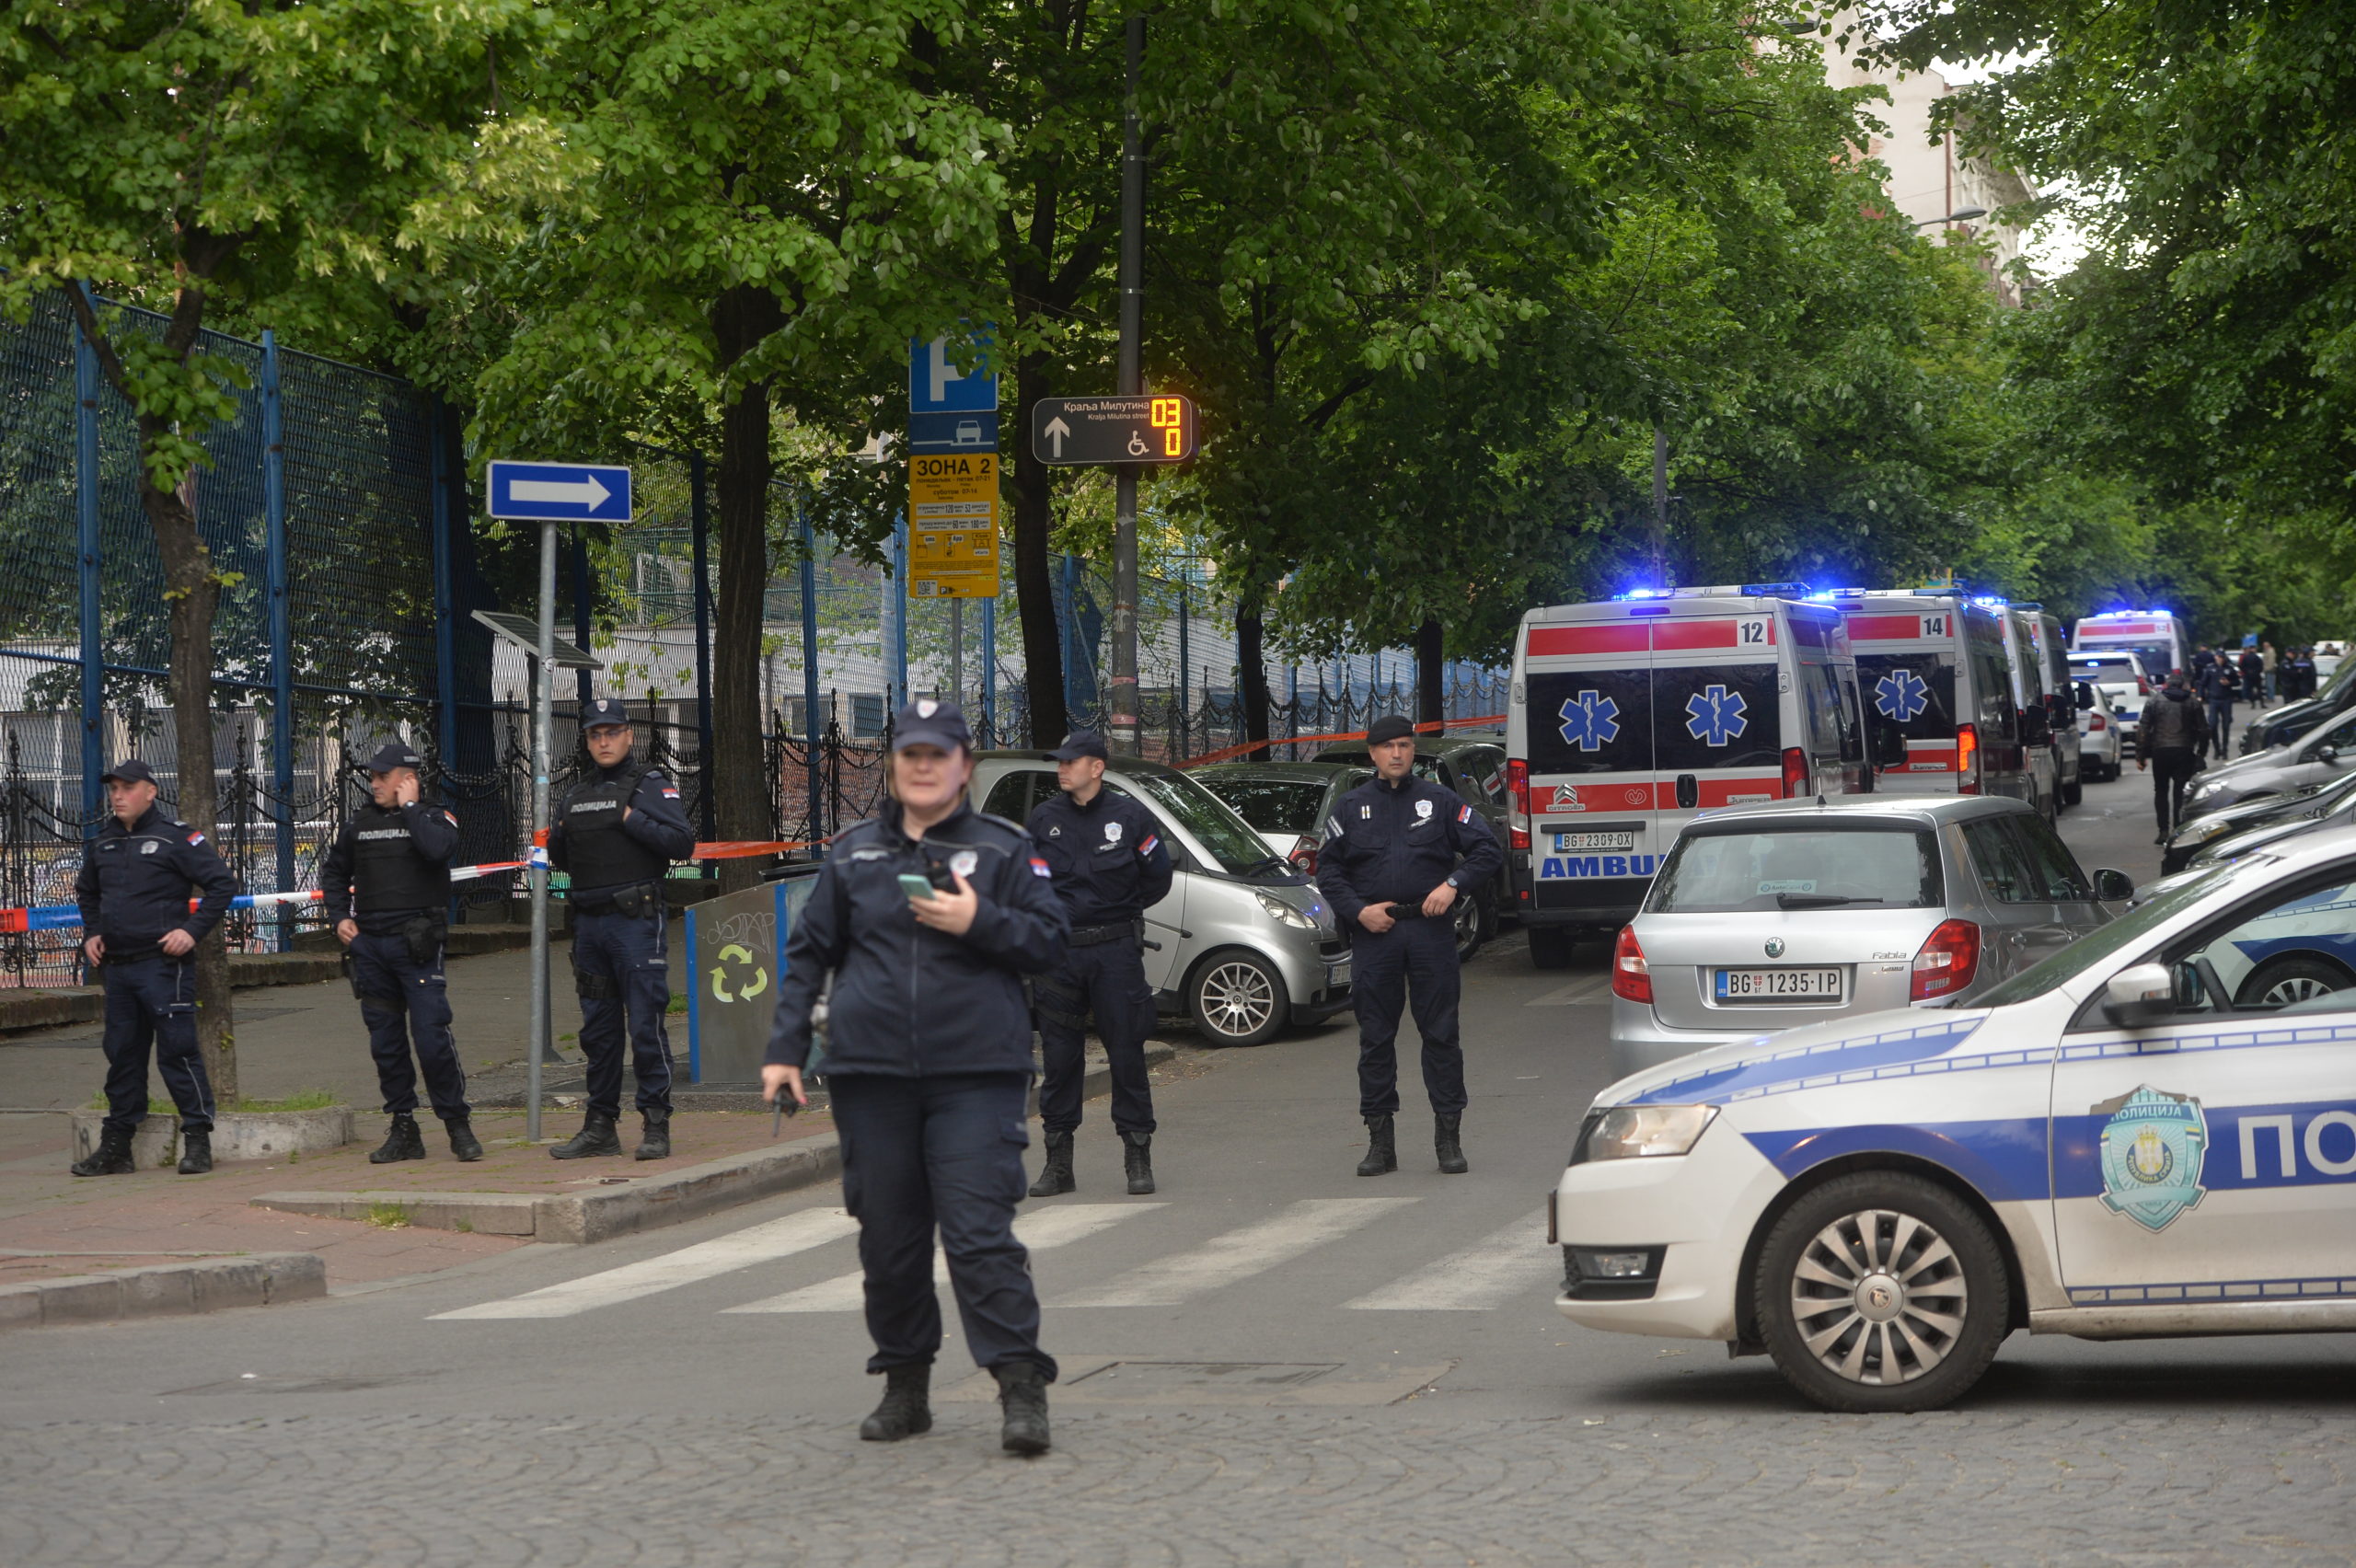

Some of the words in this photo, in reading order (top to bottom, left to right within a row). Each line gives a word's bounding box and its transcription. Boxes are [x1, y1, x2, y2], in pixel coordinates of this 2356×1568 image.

[1064, 402, 1098, 412] Краља
[1101, 401, 1149, 413] Милутина
[1151, 398, 1181, 427] 03
[1165, 428, 1181, 456] 0
[917, 459, 971, 476] ЗОНА
[980, 458, 991, 474] 2
[1740, 621, 1763, 643] 12
[1923, 617, 1944, 635] 14
[570, 800, 618, 814] ПОЛИЦИЈА
[358, 828, 411, 840] ПОЛИЦИЈА
[1564, 835, 1577, 847] BG
[1541, 853, 1666, 879] AMBU
[1872, 951, 1907, 960] Fabia
[1730, 974, 1750, 994] BG
[2238, 1110, 2356, 1180] ПО
